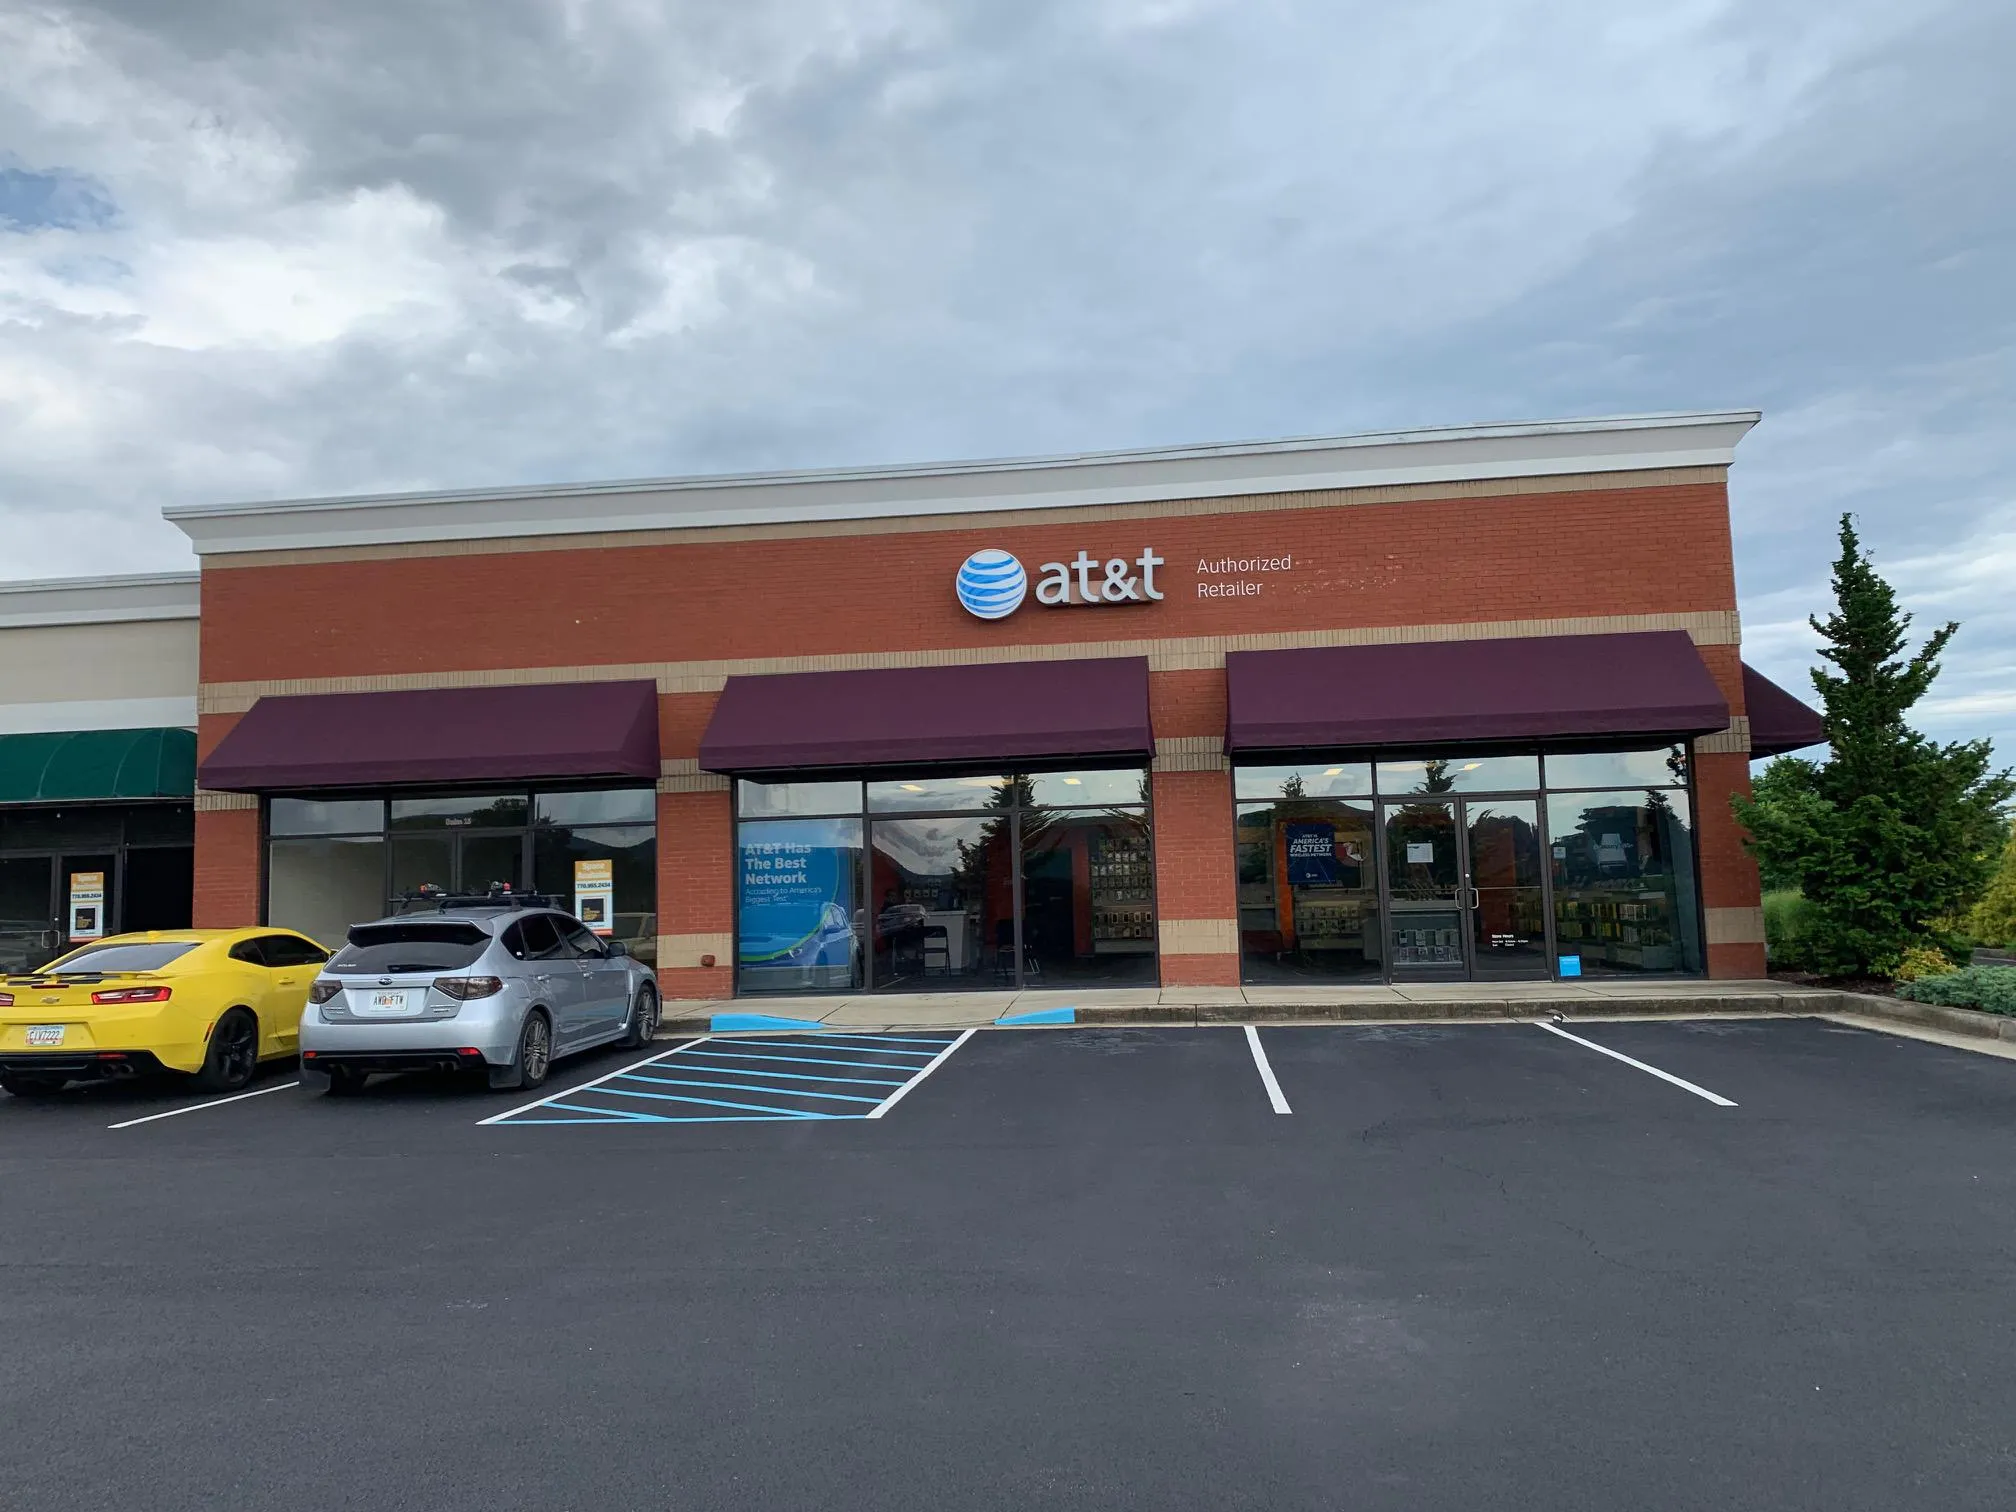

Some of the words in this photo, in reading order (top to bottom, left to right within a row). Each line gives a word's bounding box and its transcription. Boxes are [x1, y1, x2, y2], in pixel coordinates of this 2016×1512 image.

[1197, 554, 1291, 574] Authorized
[1035, 547, 1165, 604] at&t
[1197, 581, 1263, 598] Retailer
[745, 843, 781, 855] AT&T
[785, 842, 811, 854] Has
[1290, 844, 1332, 853] FASTEST
[745, 858, 771, 870] The
[775, 857, 807, 869] Best
[745, 871, 807, 885] Network
